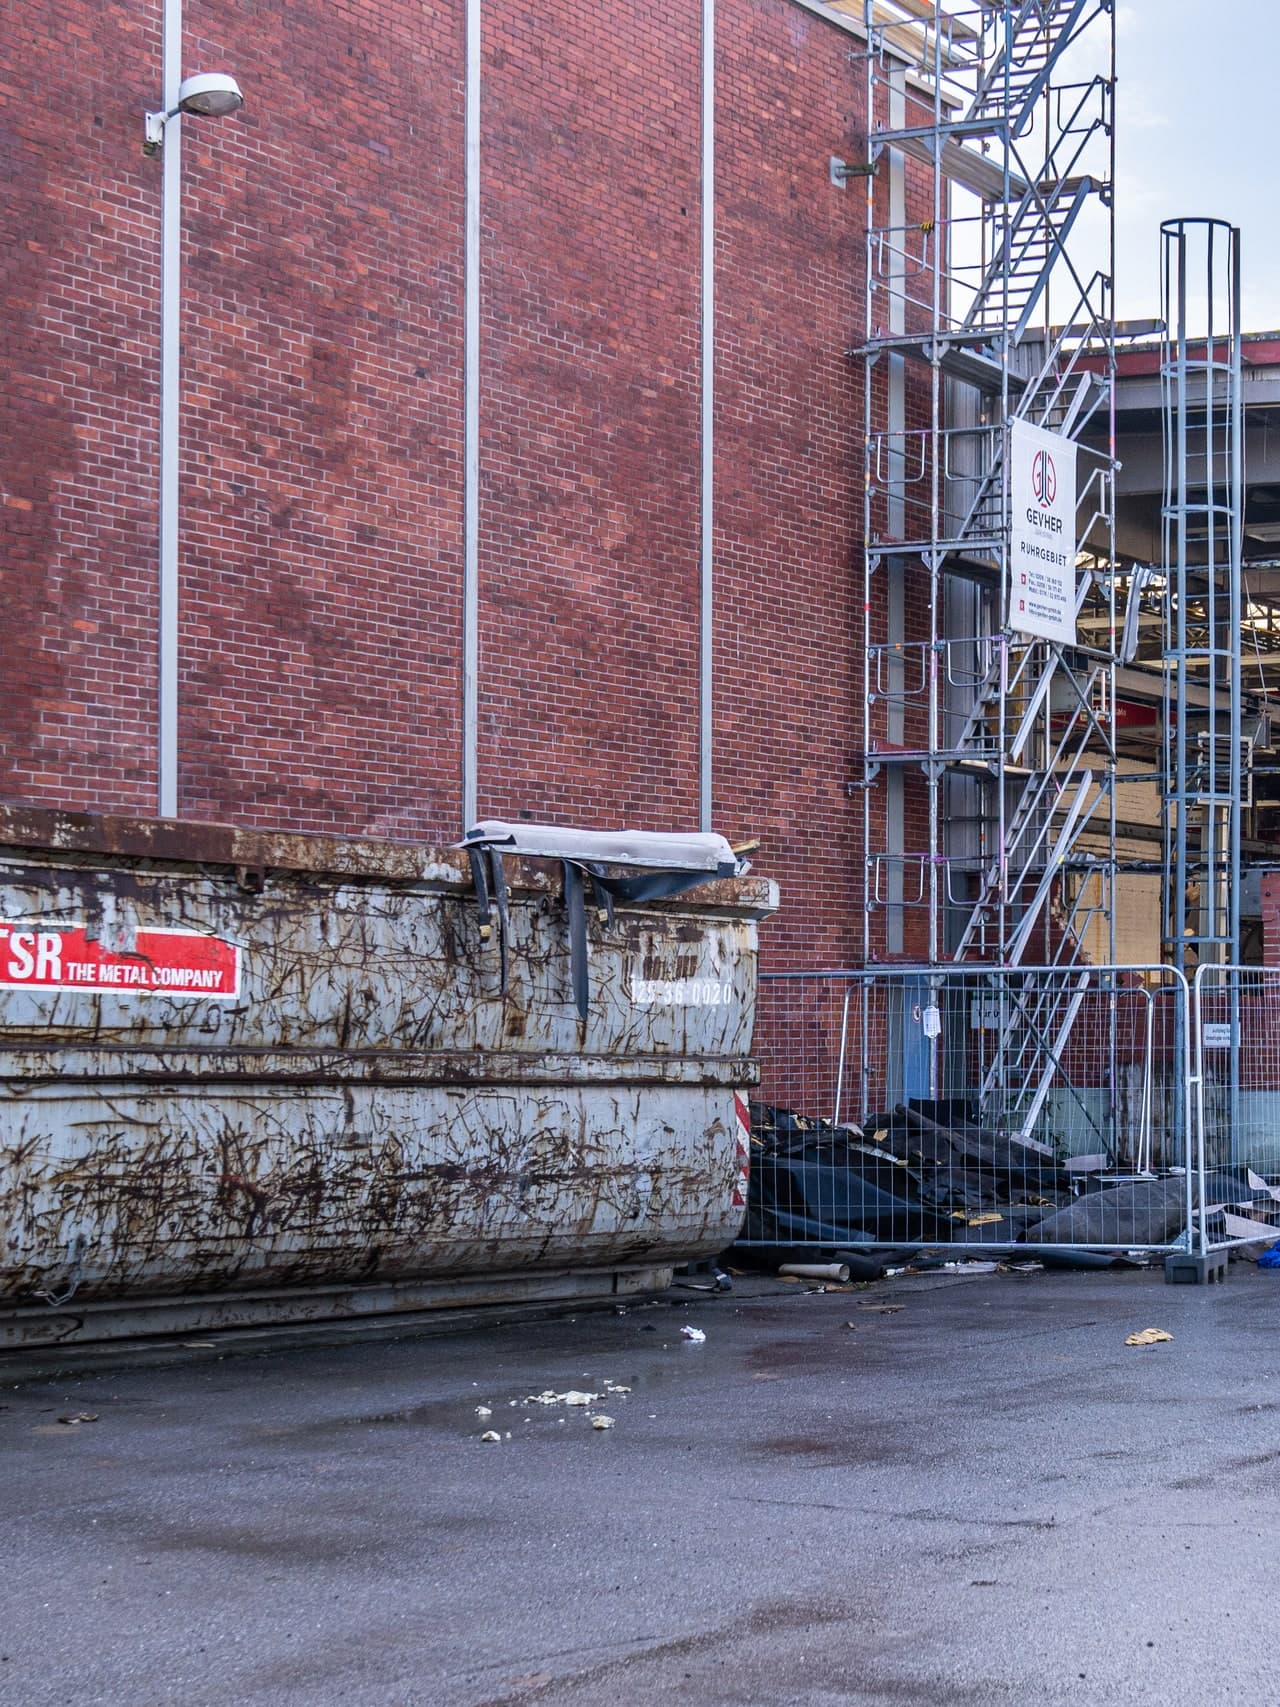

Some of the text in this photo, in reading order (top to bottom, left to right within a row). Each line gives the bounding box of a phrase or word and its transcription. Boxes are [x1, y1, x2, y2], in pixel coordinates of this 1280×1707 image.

[1026, 508, 1062, 534] GEVHER
[1020, 541, 1067, 567] RUHRGEBIET
[66, 962, 97, 982] THE
[98, 964, 150, 985] METAL
[152, 967, 224, 988] COMPANY
